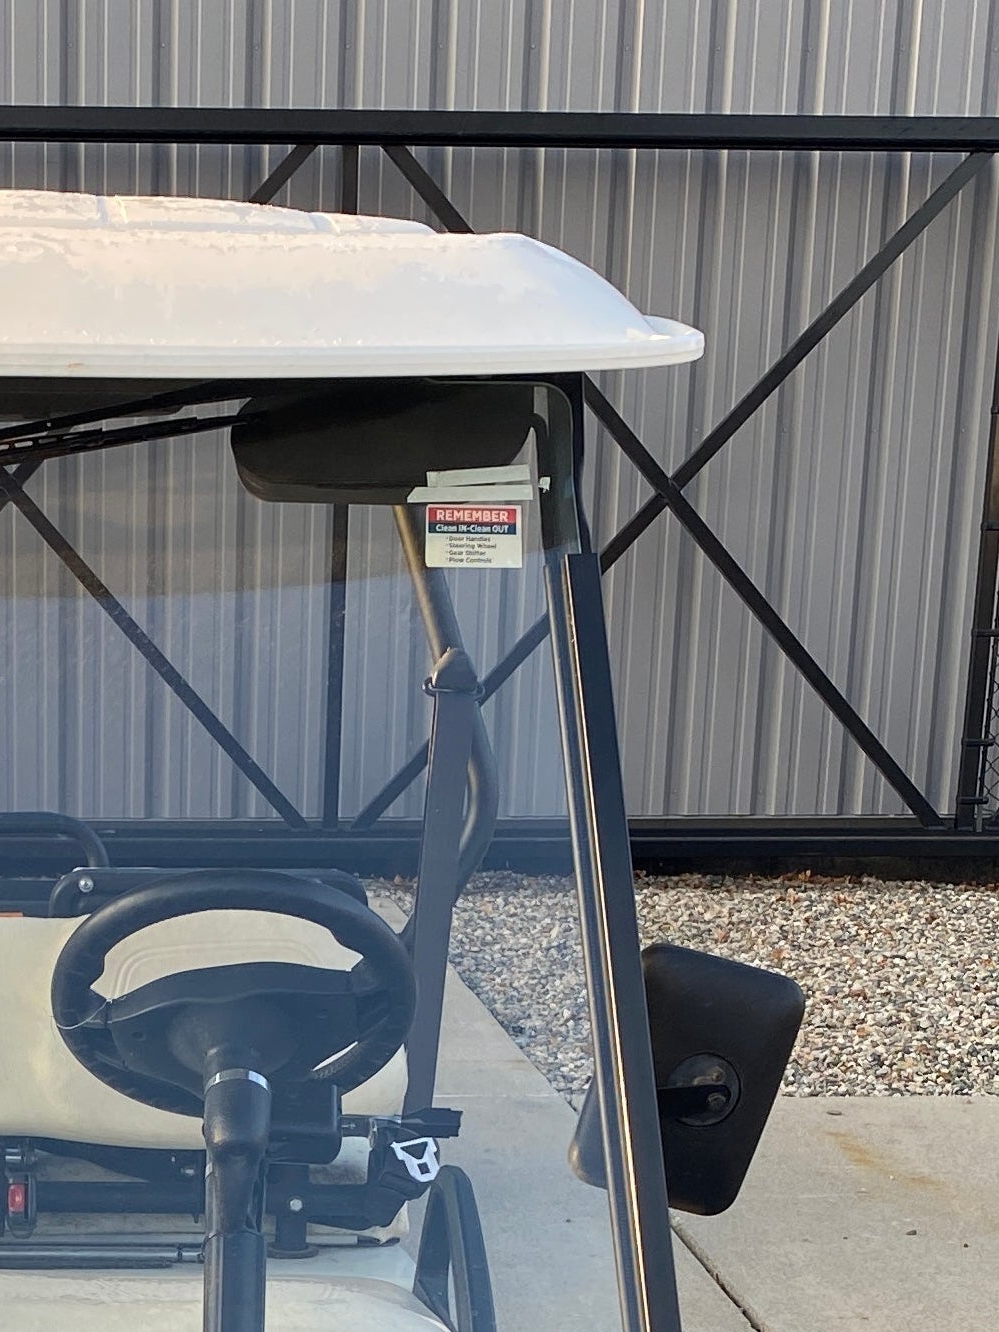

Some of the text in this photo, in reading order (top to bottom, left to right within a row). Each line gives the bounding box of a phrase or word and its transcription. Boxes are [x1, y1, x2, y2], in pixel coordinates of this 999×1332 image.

[437, 509, 508, 522] REMEMBER
[436, 524, 457, 532] Clean
[493, 525, 509, 533] OUT
